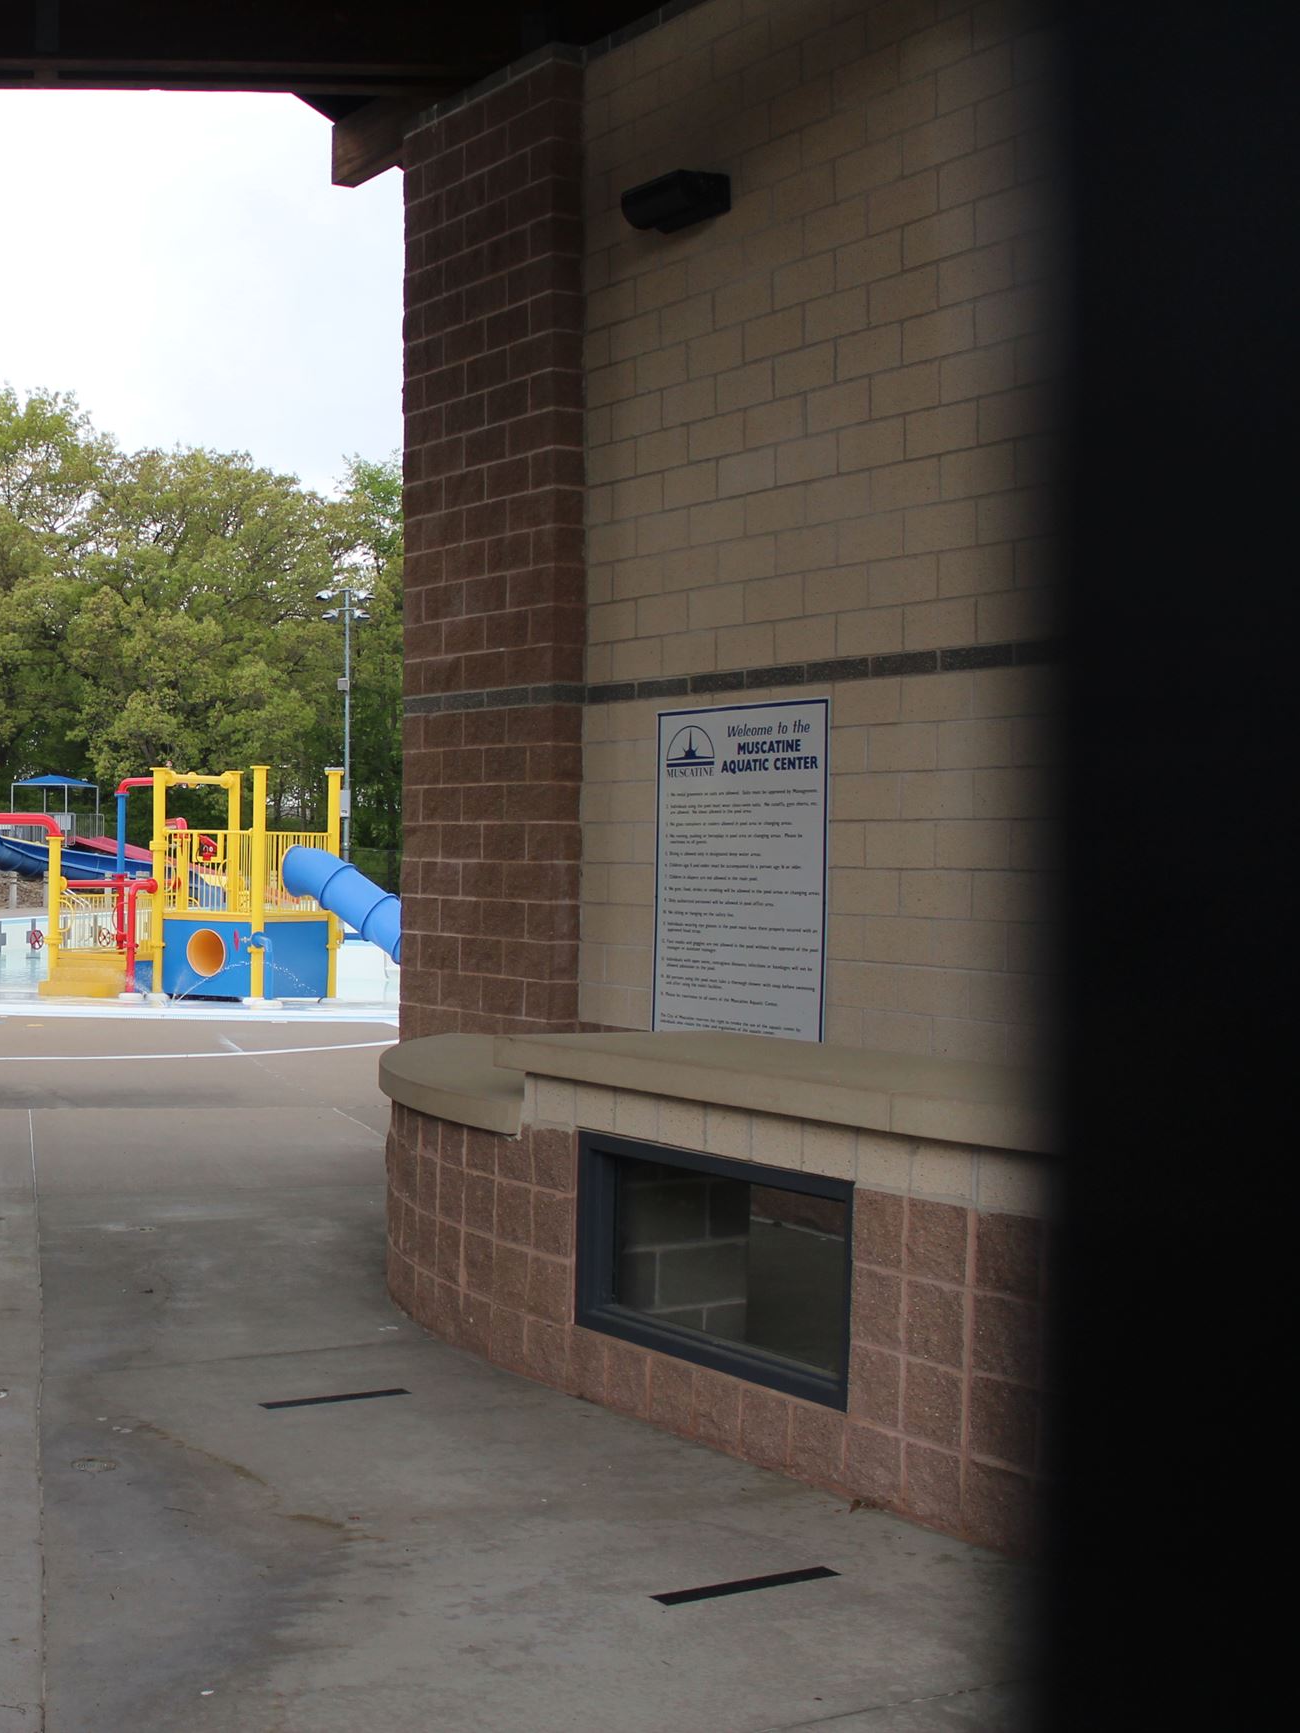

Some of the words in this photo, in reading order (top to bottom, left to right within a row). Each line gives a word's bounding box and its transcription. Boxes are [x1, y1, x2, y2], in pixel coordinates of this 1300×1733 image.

[727, 722, 773, 738] Welcome
[777, 721, 788, 735] to
[793, 719, 811, 734] the
[737, 739, 801, 755] MUSCATINE
[666, 767, 714, 778] MUSCATINE
[721, 758, 769, 775] AQUATIC
[773, 756, 818, 771] CENTER
